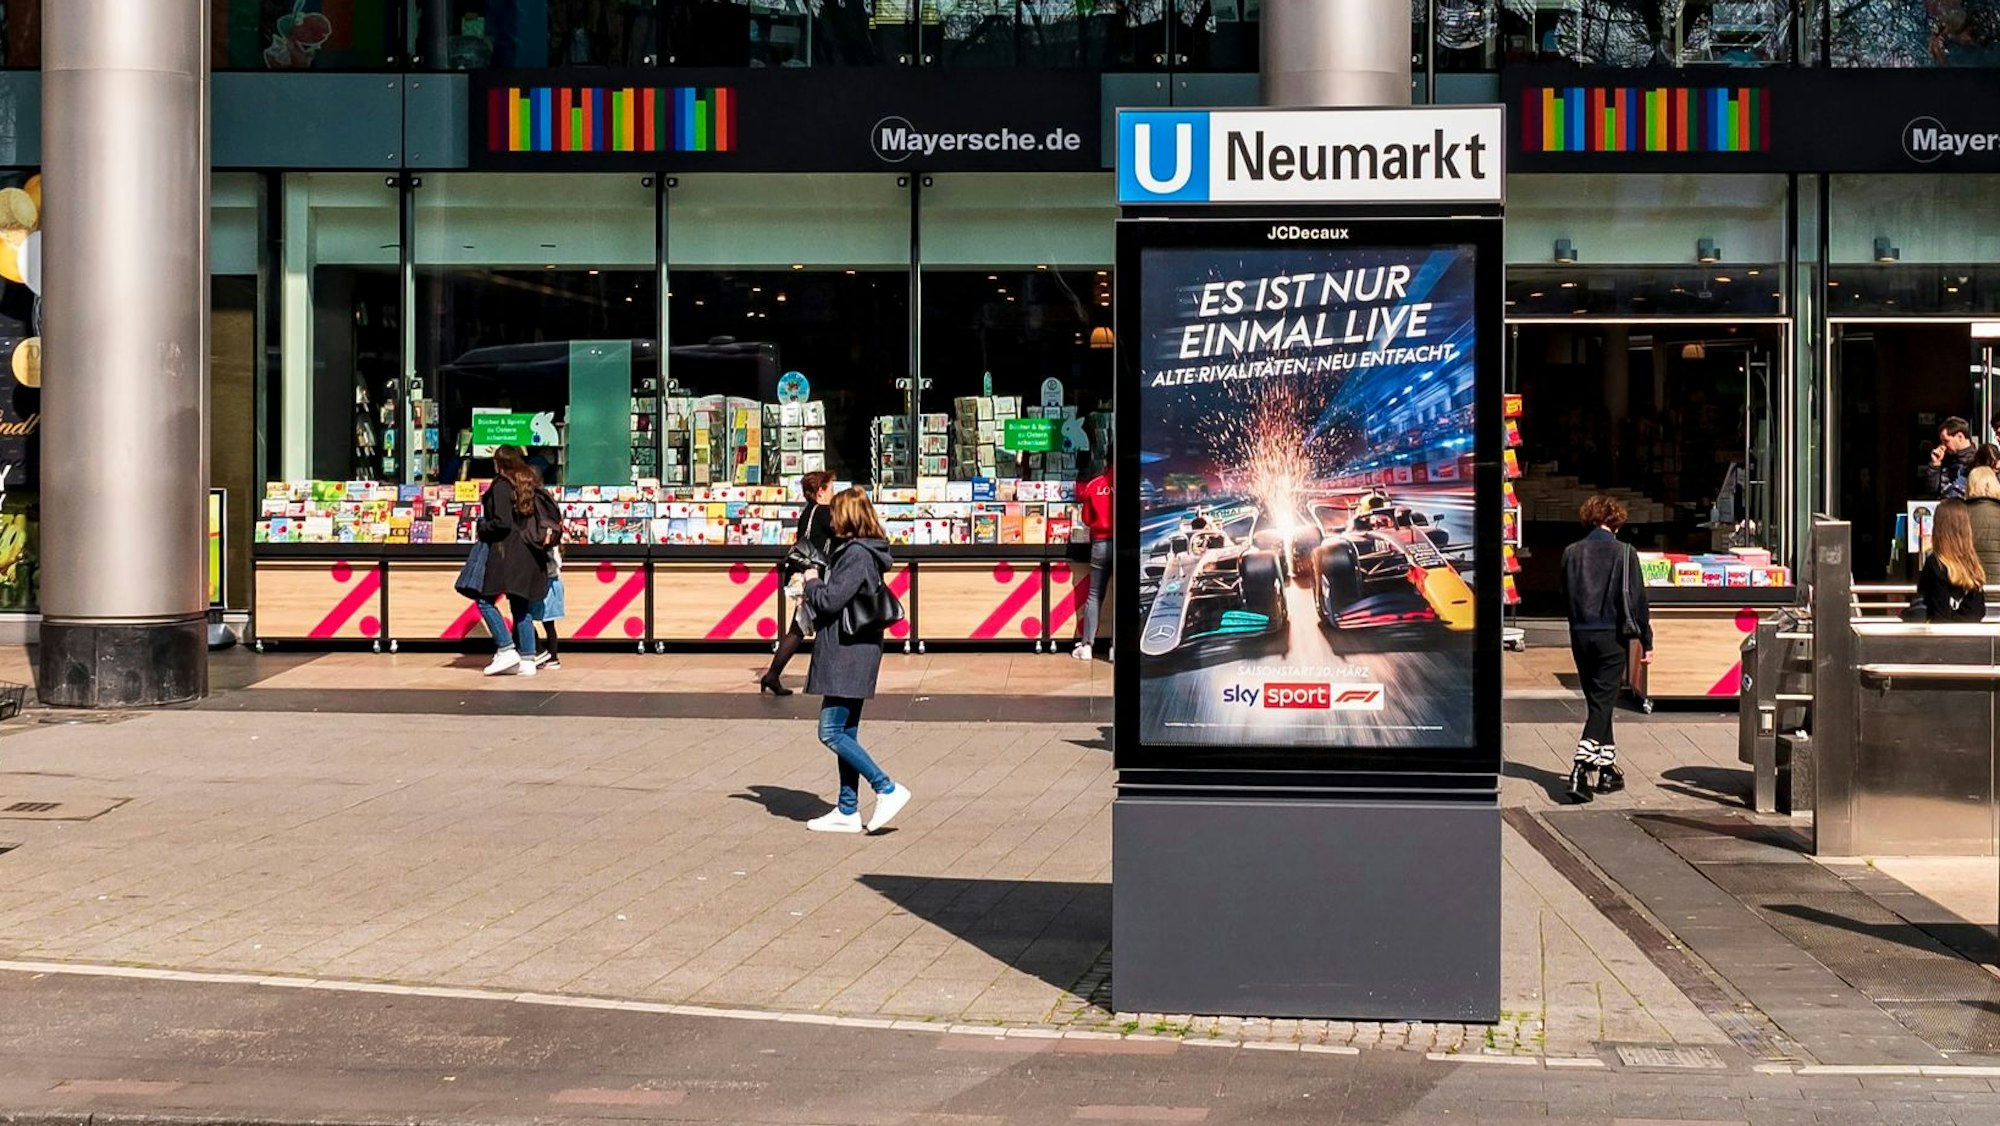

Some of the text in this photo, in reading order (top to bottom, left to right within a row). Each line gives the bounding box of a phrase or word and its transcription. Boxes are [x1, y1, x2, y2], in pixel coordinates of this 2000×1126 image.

[880, 127, 1081, 156] Mayersche.de
[1912, 127, 2000, 156] Mayer
[1134, 122, 1486, 194] U Neumarkt
[1267, 226, 1349, 240] JCDecaux
[1199, 264, 1410, 317] ES IST NUR
[1179, 302, 1432, 359] EINMAL LIVE
[1151, 368, 1196, 387] ALTE
[1198, 357, 1312, 383] RIVALITÄTEN,
[1317, 353, 1356, 371] NEU
[1237, 665, 1316, 677] SAISONSTART
[1336, 664, 1370, 677] MÄRZ
[1223, 684, 1260, 707] sky
[1267, 686, 1327, 707] sport
